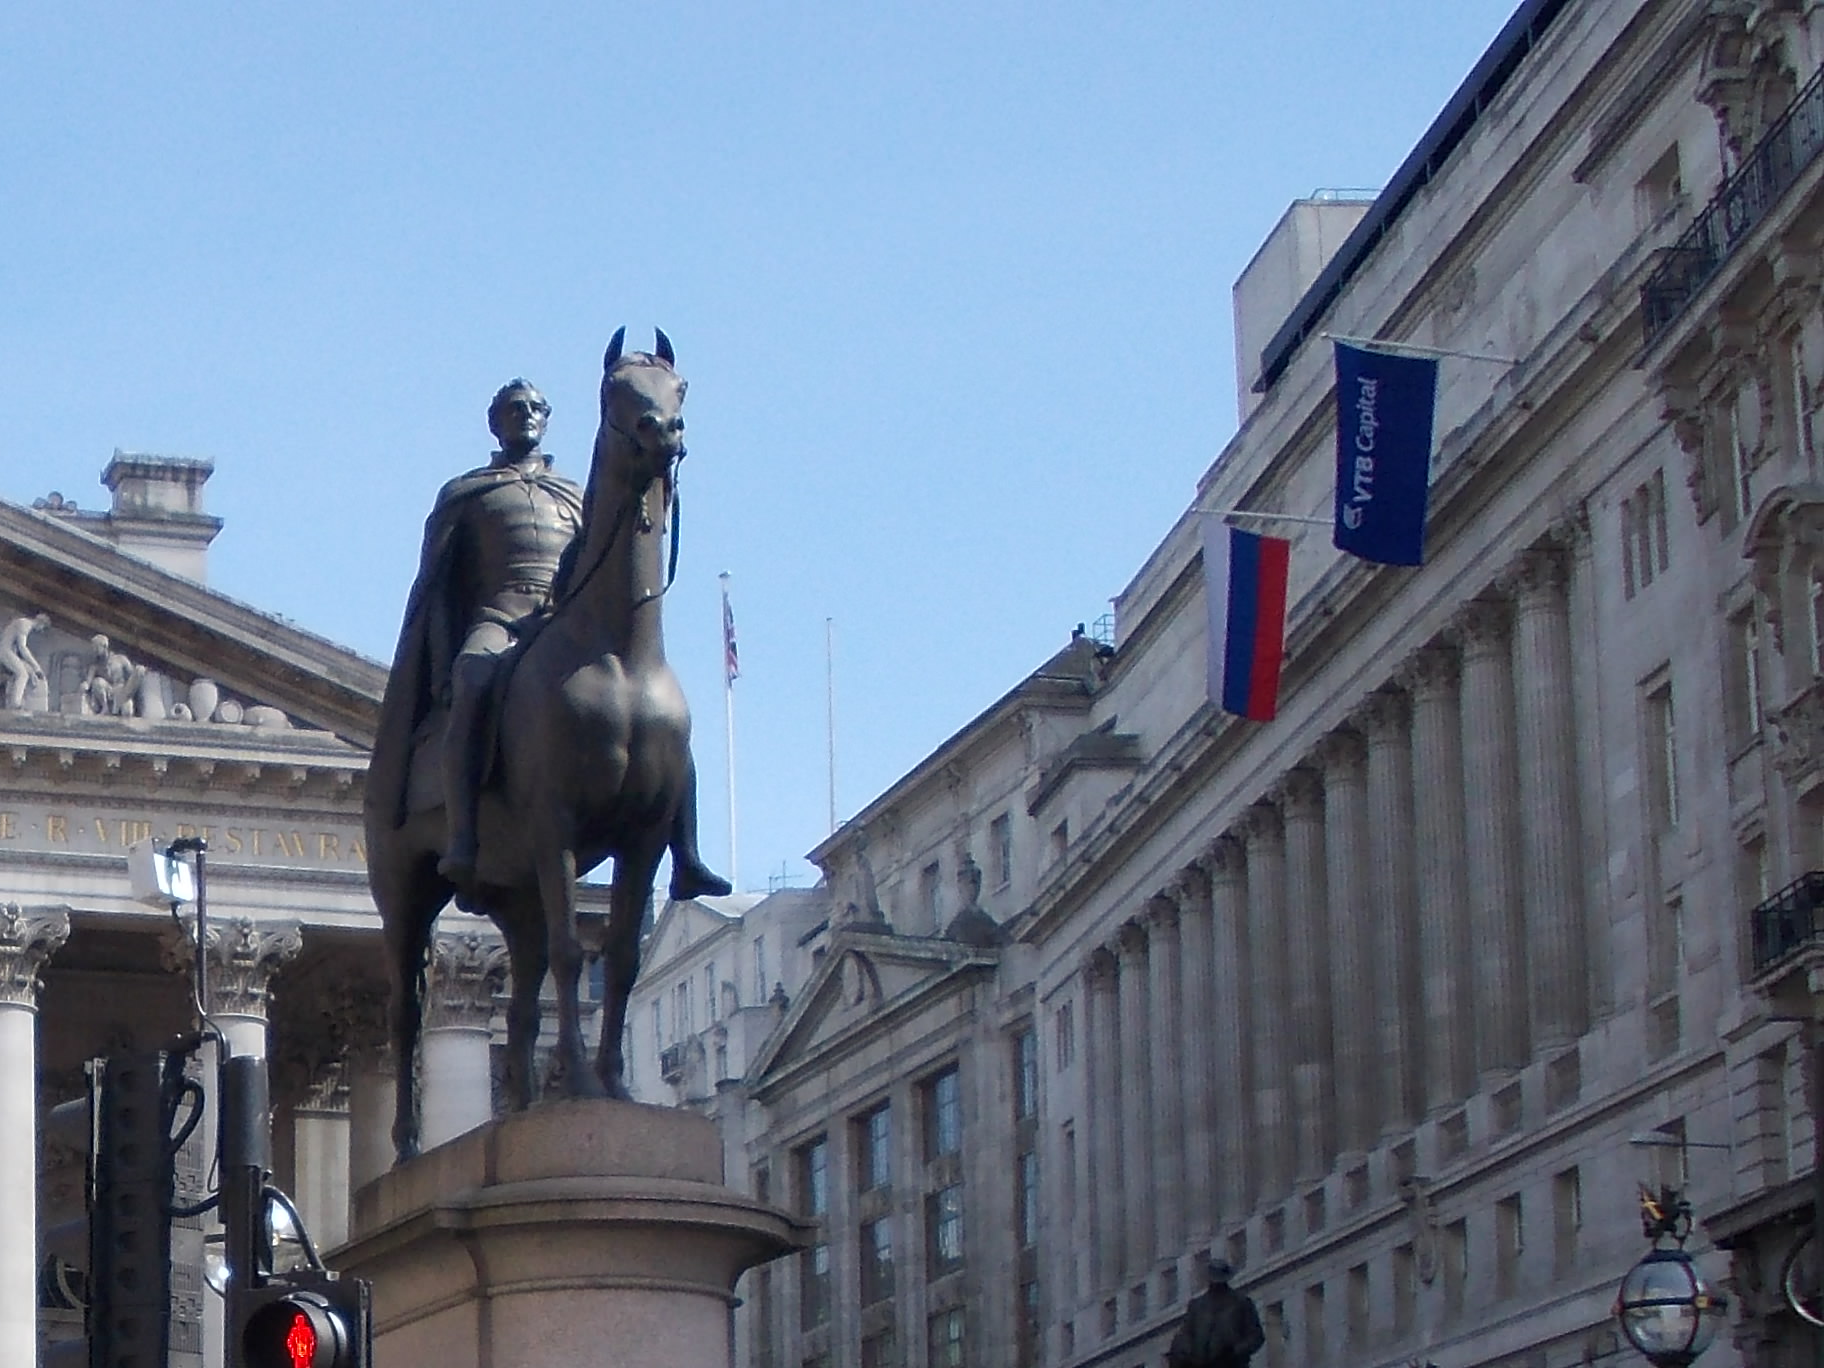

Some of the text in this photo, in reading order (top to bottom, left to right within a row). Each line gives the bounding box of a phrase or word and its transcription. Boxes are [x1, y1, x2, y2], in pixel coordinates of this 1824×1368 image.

[1352, 376, 1378, 503] VTB Capital
[46, 814, 69, 842] R
